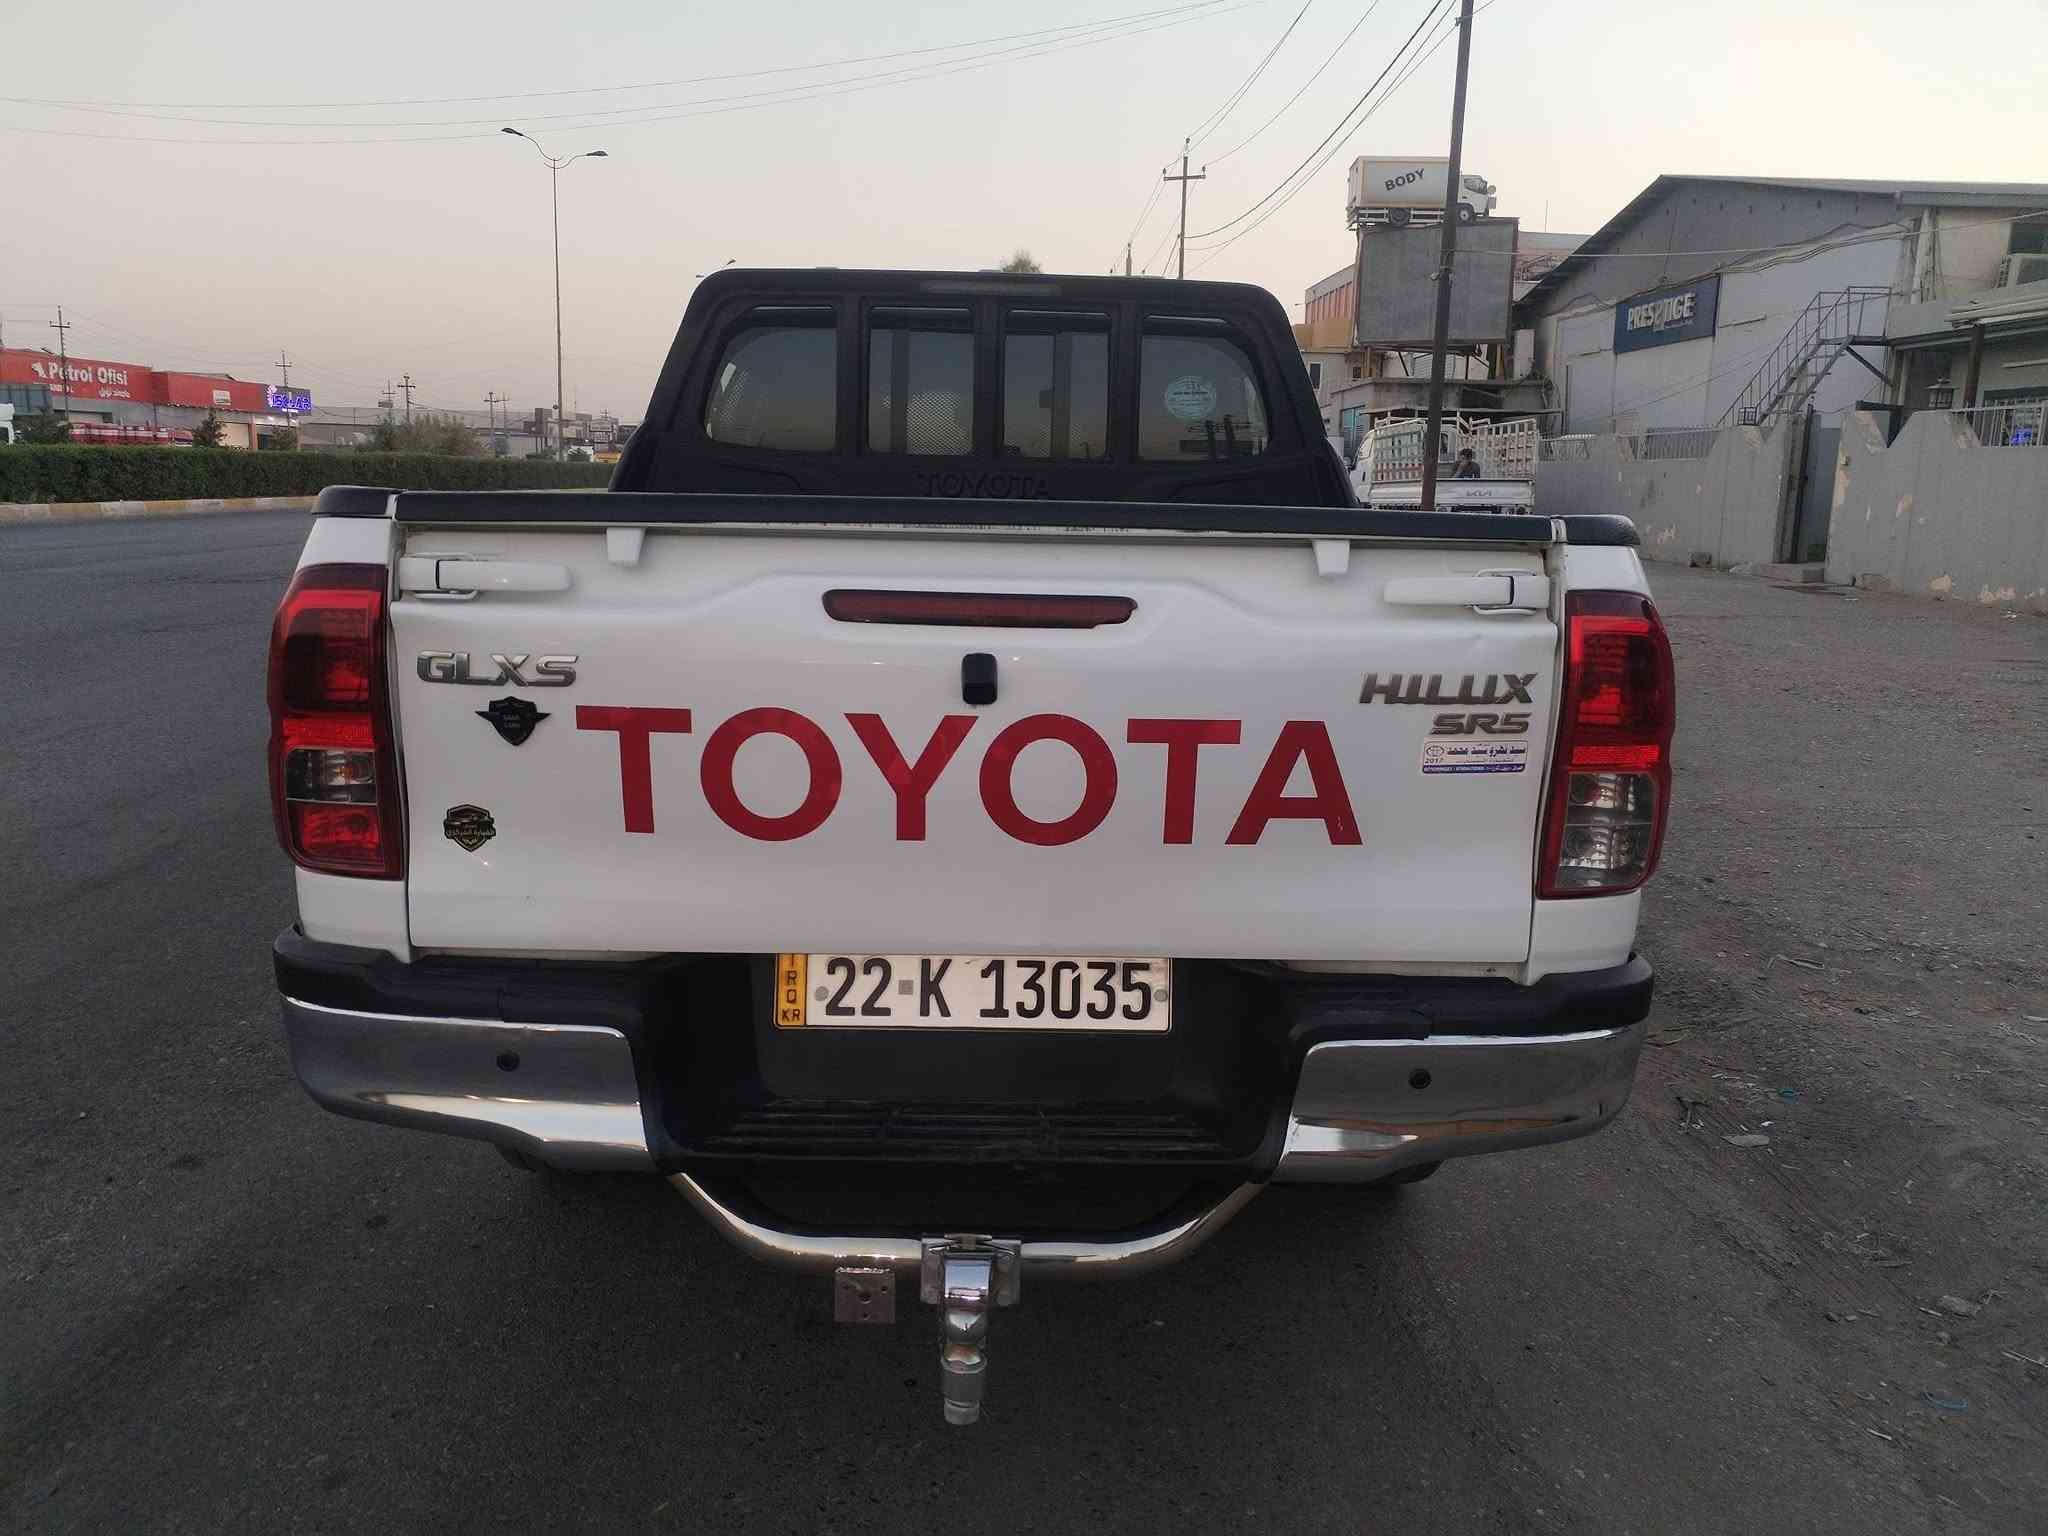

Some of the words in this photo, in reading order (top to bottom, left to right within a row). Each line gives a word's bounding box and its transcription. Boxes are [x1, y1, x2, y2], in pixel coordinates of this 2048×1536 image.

[1384, 168, 1424, 191] BODY
[97, 367, 128, 385] Ofisi
[916, 472, 1049, 499] TOYOTA
[416, 650, 579, 687] GLXS
[1359, 672, 1538, 704] HILUX
[1430, 712, 1532, 735] SR5
[576, 705, 1364, 846] TOYOTA
[826, 957, 891, 1017] 22
[919, 958, 952, 1018] K
[979, 959, 1152, 1020] 13035
[782, 1008, 801, 1022] KR
